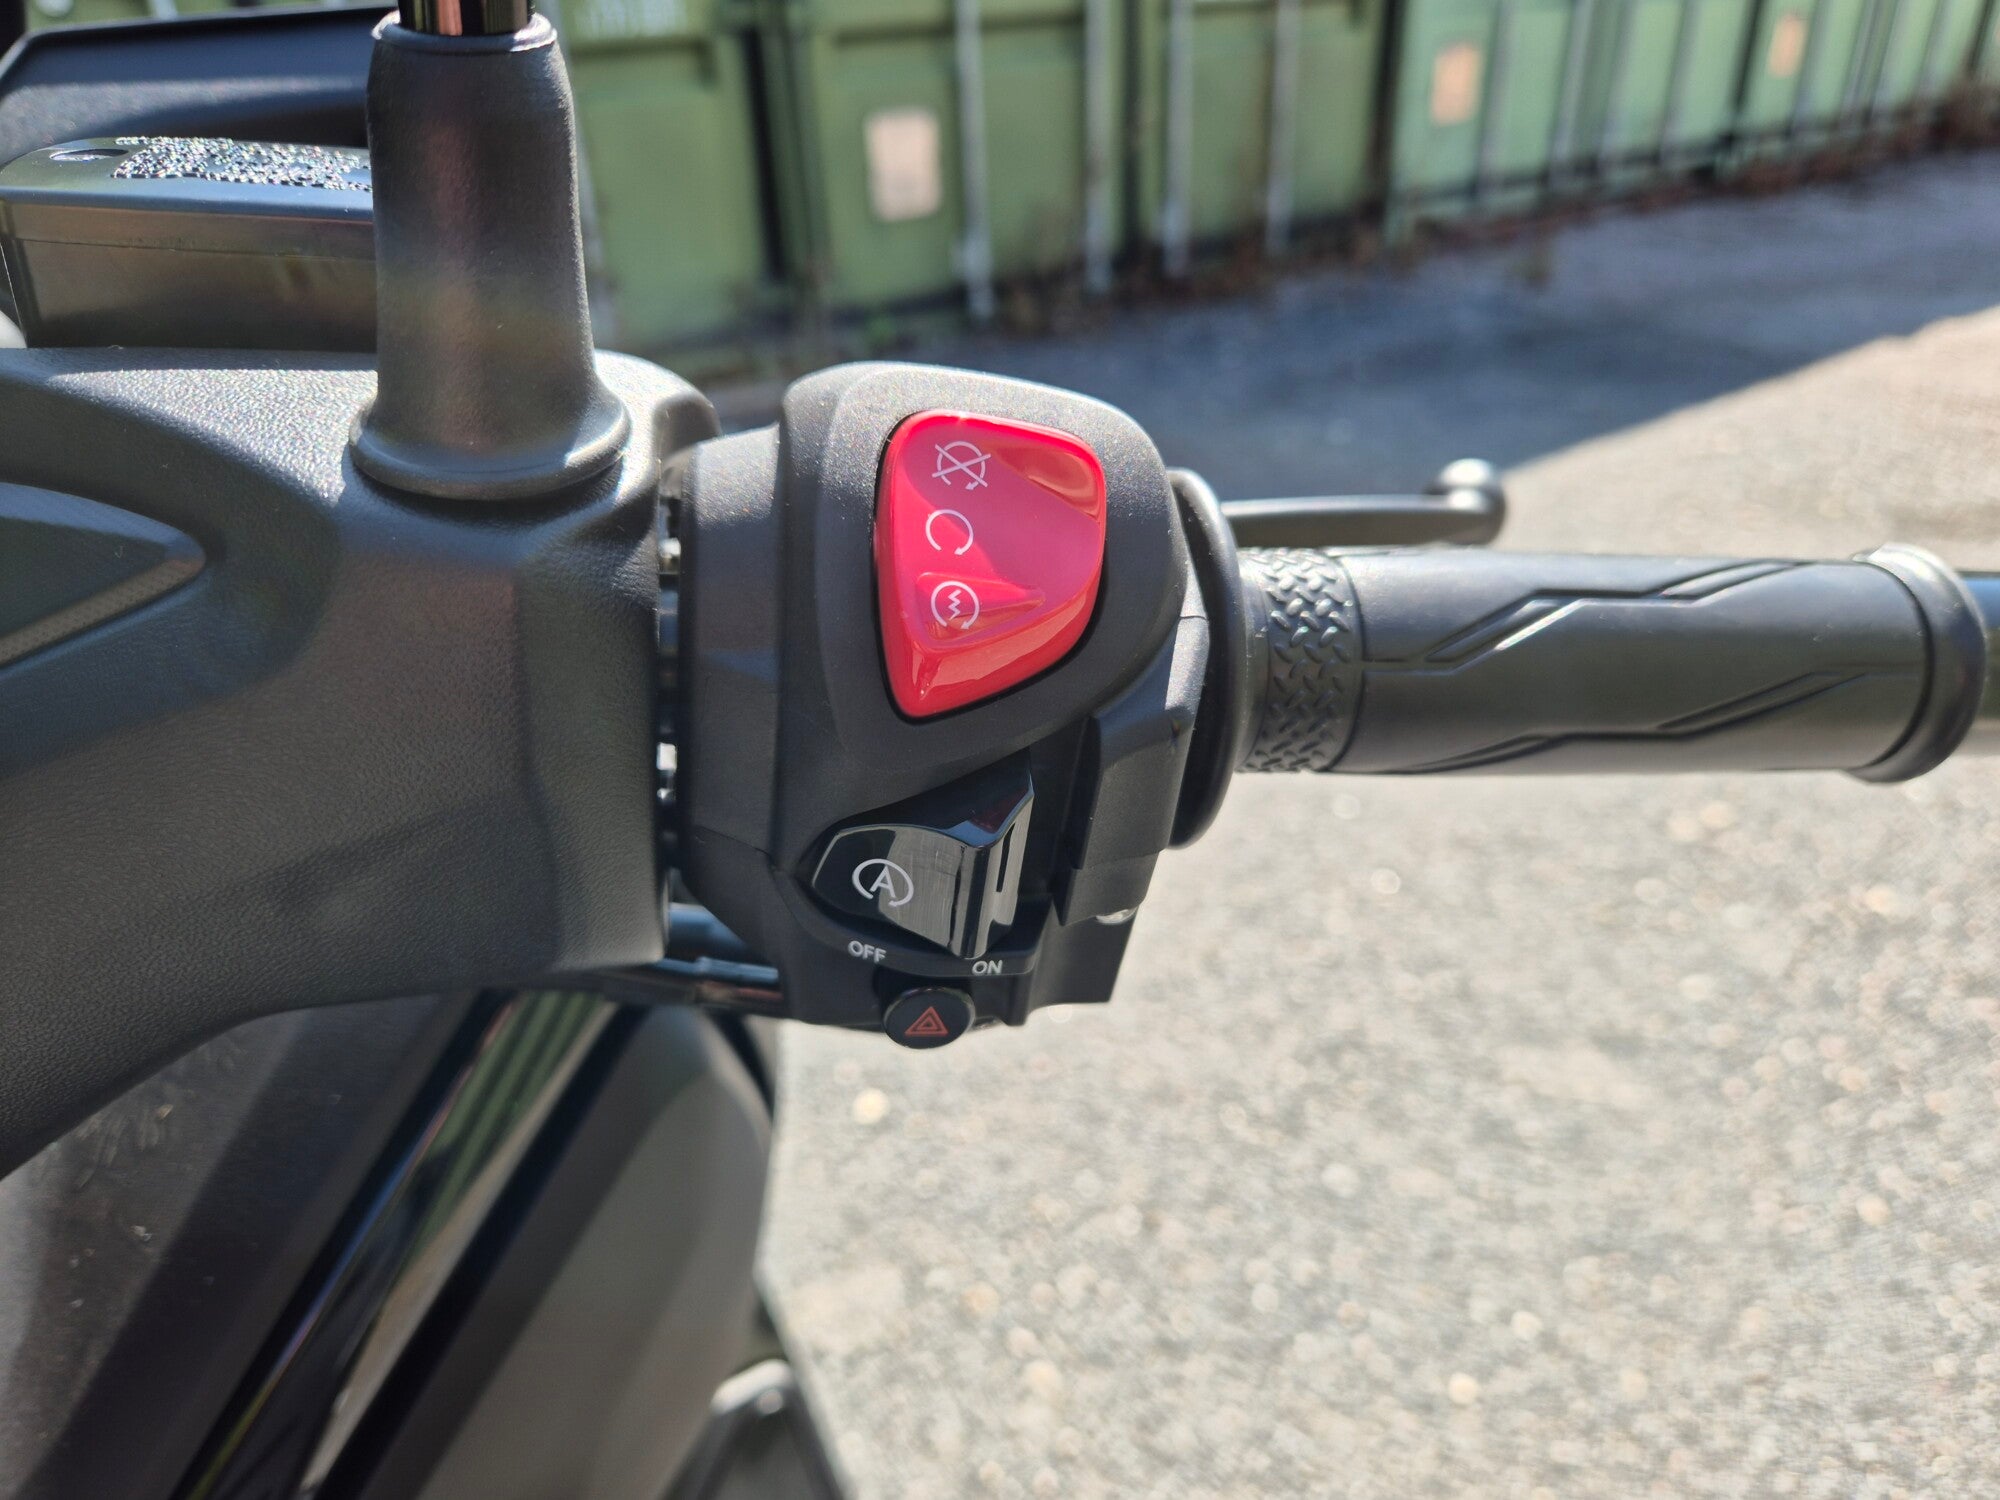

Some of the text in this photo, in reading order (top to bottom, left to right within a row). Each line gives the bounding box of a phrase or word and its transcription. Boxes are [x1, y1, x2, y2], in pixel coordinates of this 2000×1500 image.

[868, 865, 895, 898] A
[848, 940, 886, 963] OFF
[972, 960, 1003, 976] ON
